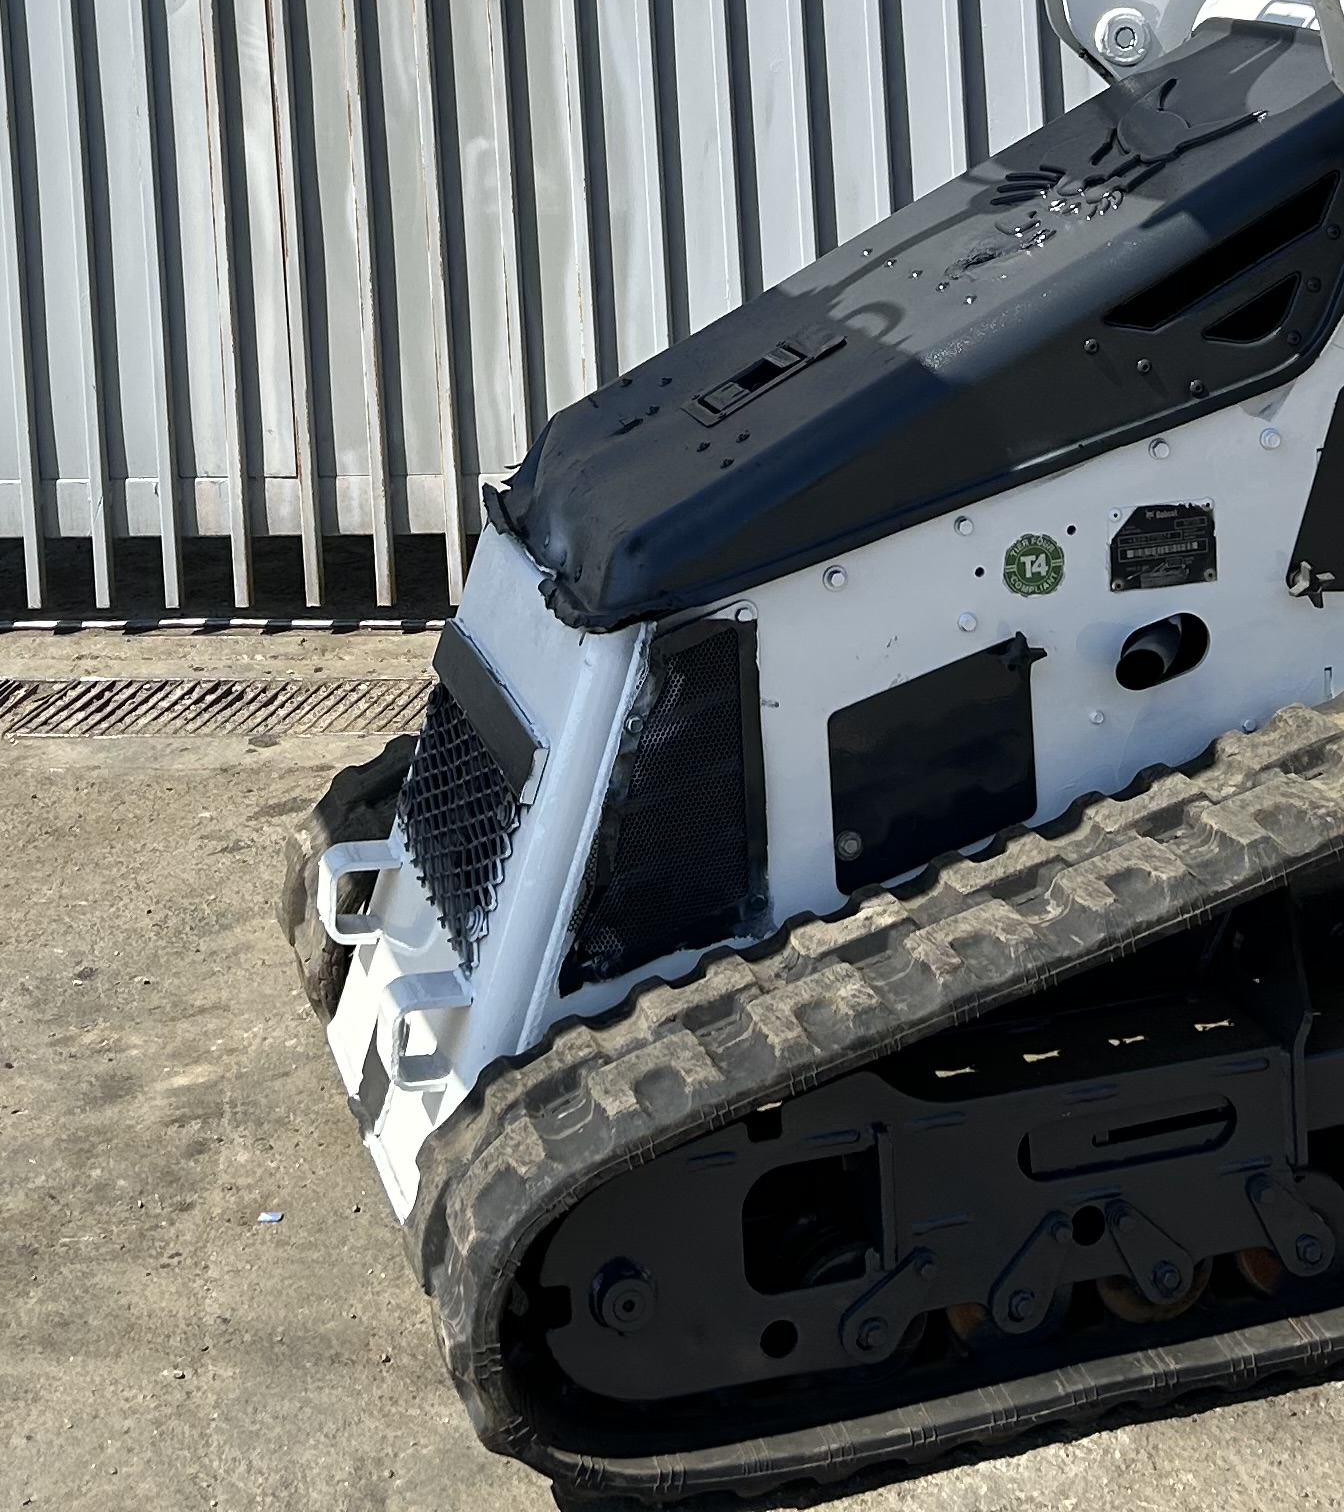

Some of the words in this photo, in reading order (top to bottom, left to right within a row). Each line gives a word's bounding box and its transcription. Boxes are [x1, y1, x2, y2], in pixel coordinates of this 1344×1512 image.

[1009, 539, 1030, 557] TIER
[1030, 537, 1056, 553] FOUR
[1020, 553, 1049, 578] T4
[1010, 572, 1058, 593] COMPLIANT
